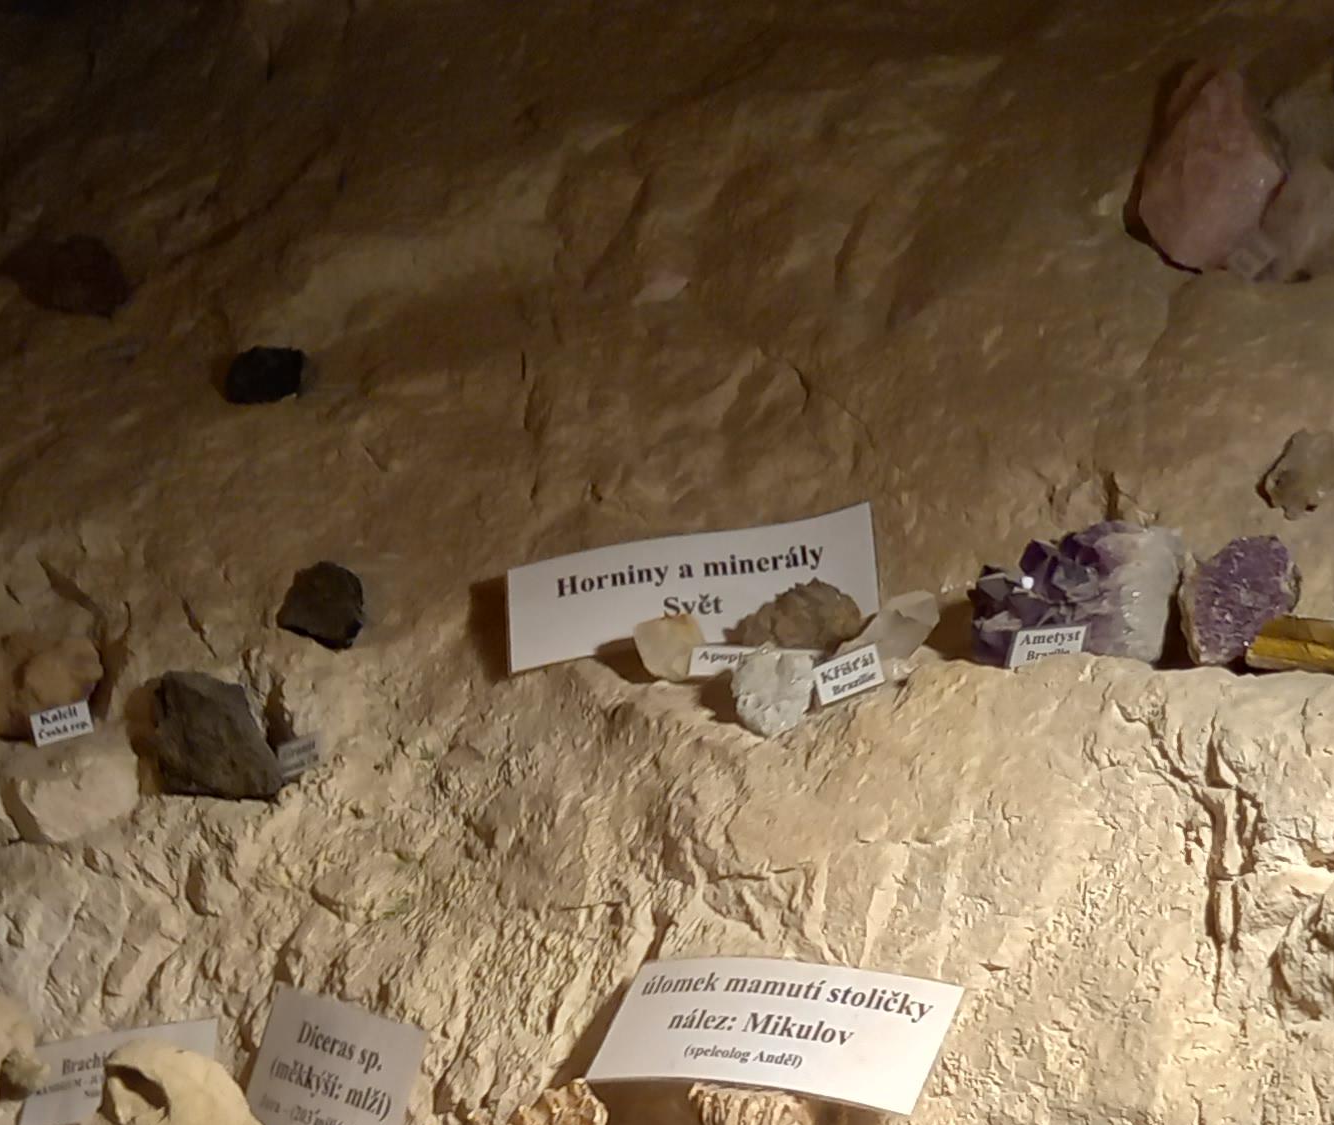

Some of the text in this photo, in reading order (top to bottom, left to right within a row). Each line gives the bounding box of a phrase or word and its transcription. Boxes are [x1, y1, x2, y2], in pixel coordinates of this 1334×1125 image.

[556, 544, 825, 599] Horniny a minerály
[663, 594, 724, 618] Svět
[1020, 631, 1081, 647] Ametyst
[40, 706, 79, 727] Kalcit
[641, 971, 935, 1024] úlomek mamutí stoličky
[667, 1007, 856, 1047] nález: Mikulov
[297, 1019, 384, 1075] Diceras sp.
[683, 1044, 804, 1071] (speleolog Anděl)
